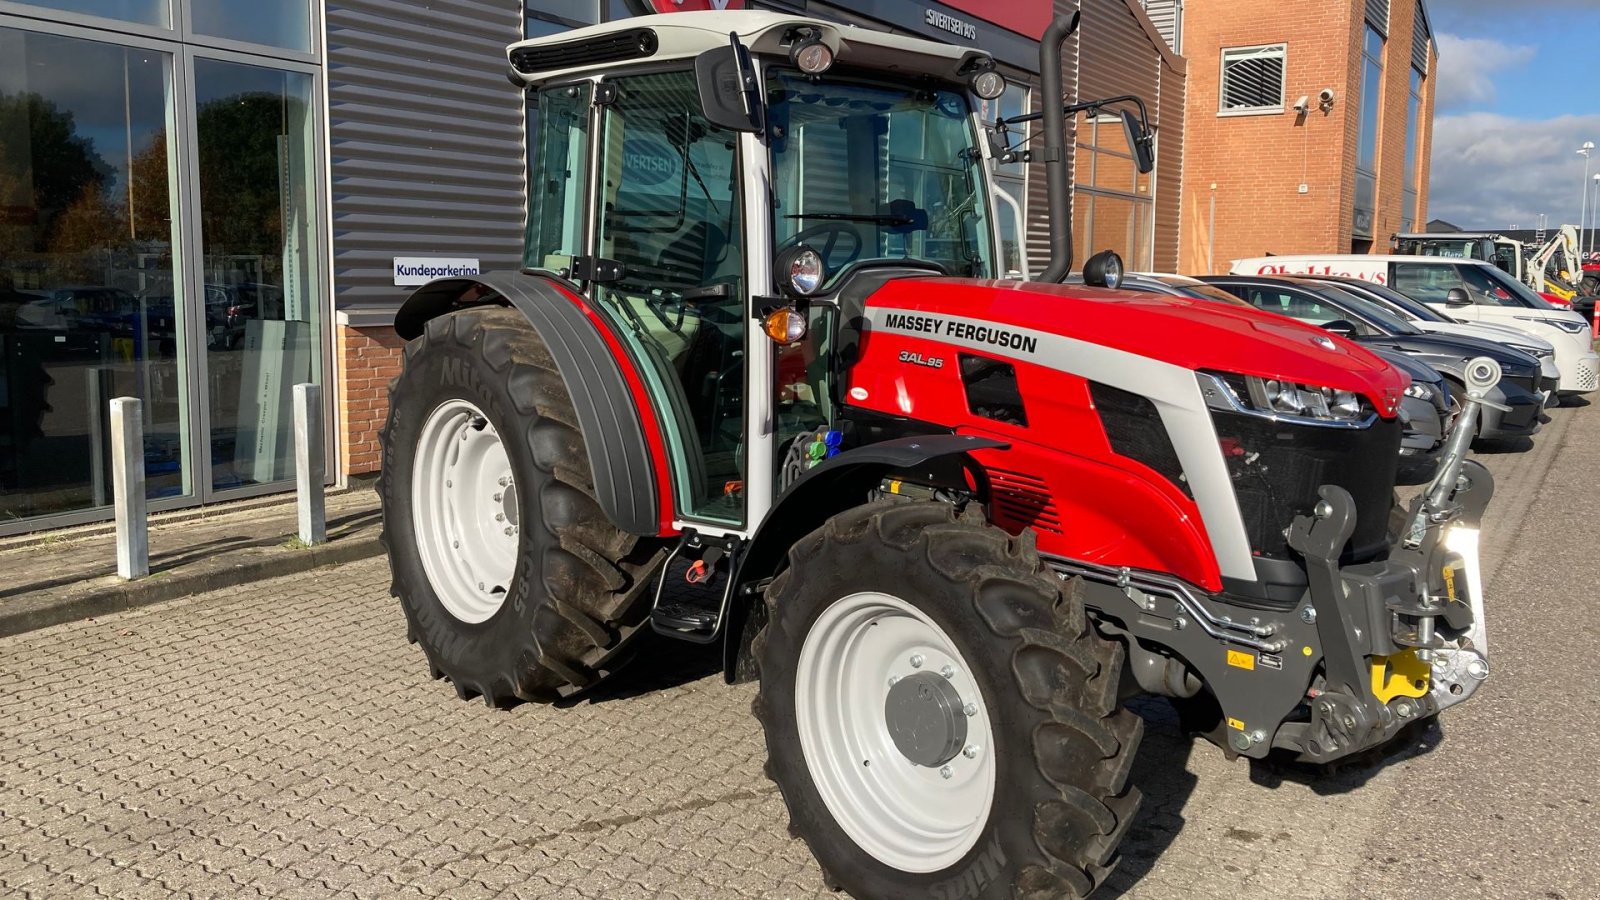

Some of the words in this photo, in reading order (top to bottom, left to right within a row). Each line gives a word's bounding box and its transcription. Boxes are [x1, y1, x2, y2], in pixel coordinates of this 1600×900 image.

[925, 9, 963, 35] SIVERTSEN
[624, 153, 672, 172] VERTSEN
[397, 264, 477, 279] Kundeparkering
[885, 314, 943, 334] MASSEY
[946, 322, 1037, 353] FERGUSON
[898, 350, 944, 368] 3AL.95
